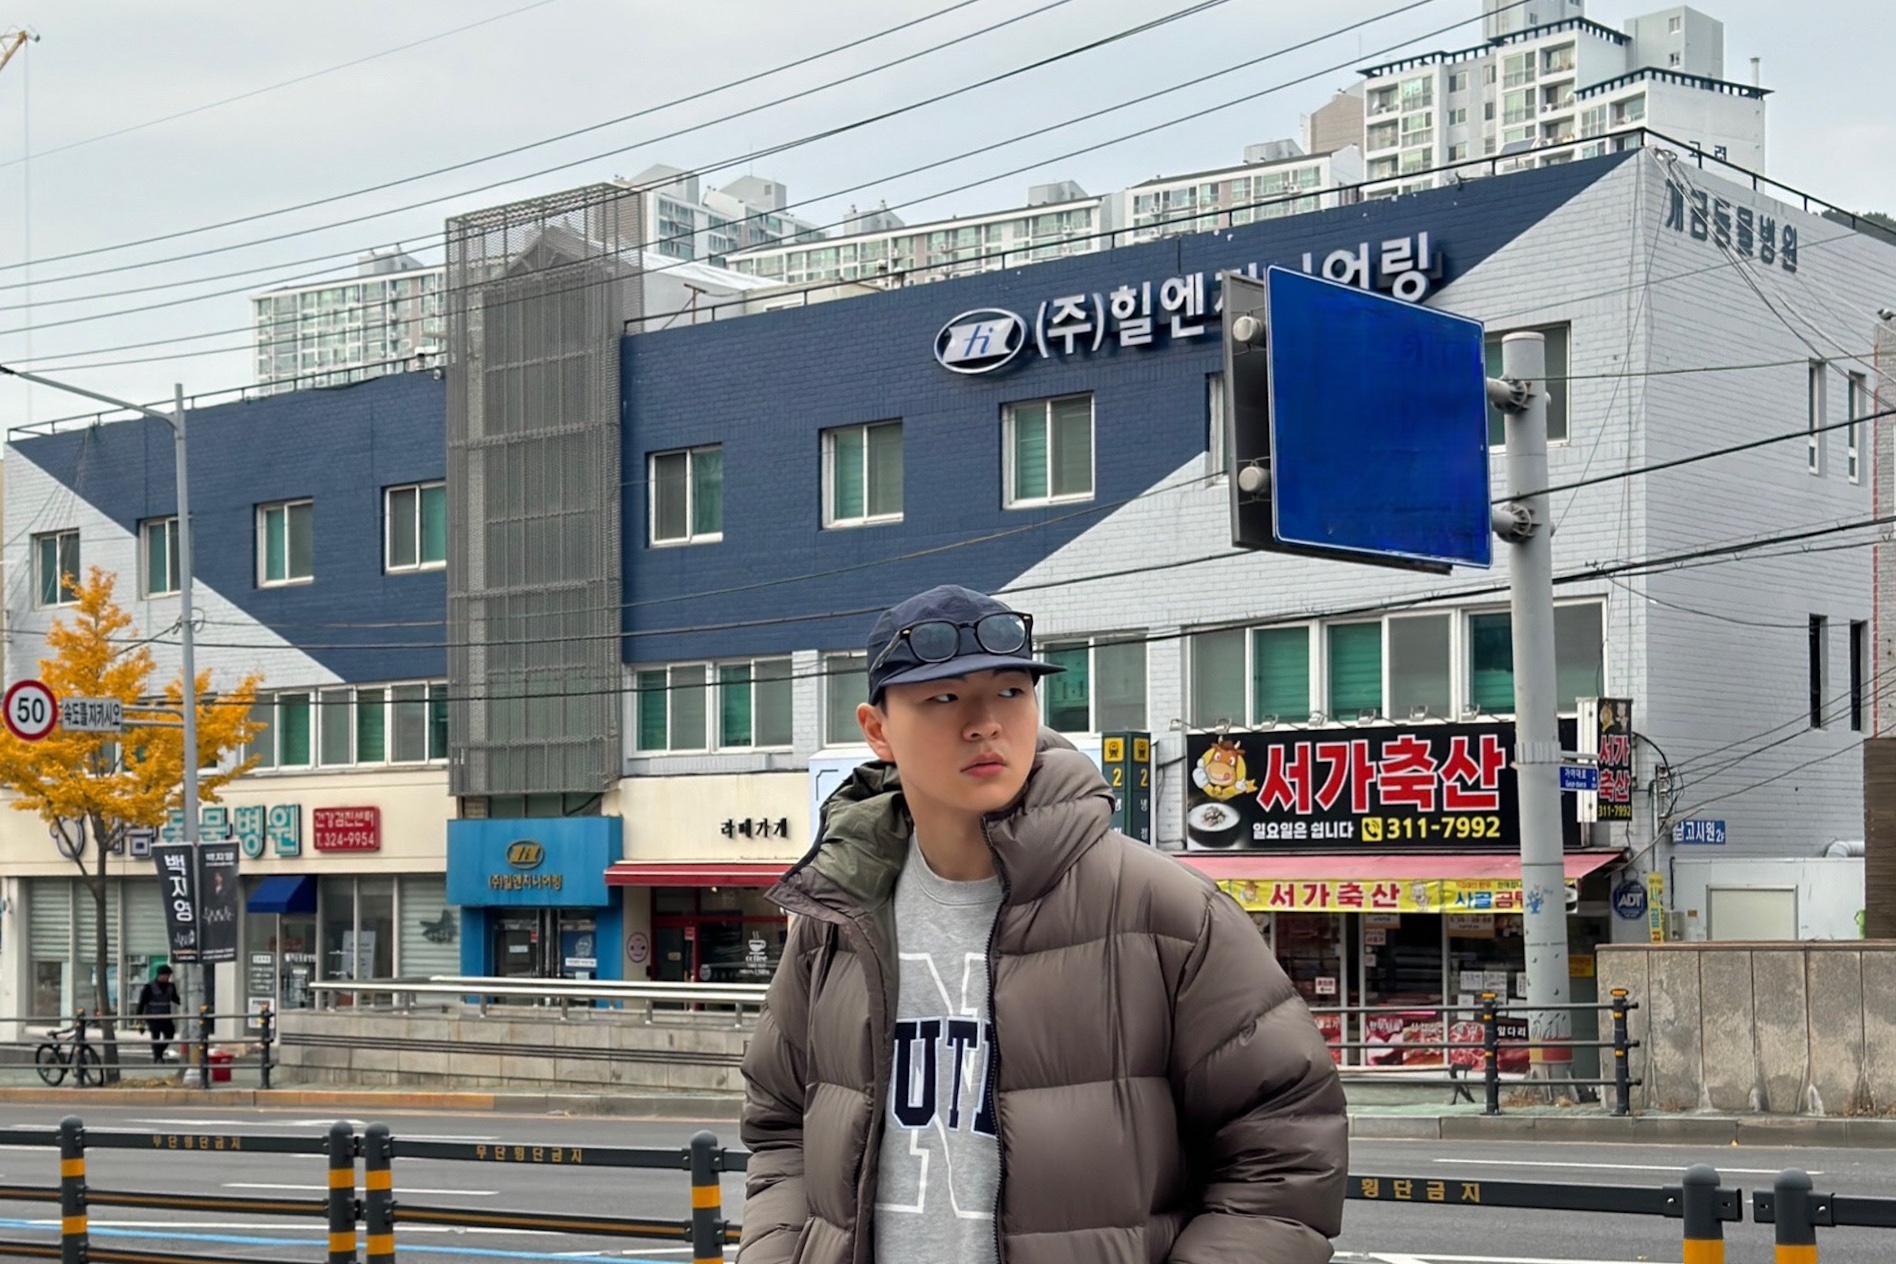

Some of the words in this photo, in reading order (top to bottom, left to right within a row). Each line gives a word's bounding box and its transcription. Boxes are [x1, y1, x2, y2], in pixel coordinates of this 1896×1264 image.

[1036, 231, 1431, 361] (주)힐엔어링
[17, 697, 45, 724] 50
[1113, 767, 1122, 787] 2
[1256, 733, 1506, 815] 서가축산
[1252, 822, 1307, 840] 일요일은
[1310, 820, 1354, 839] 쉽니다
[1386, 816, 1501, 839] 311-7992
[164, 854, 193, 922] 백지영
[1269, 882, 1400, 908] 서가축산
[1618, 893, 1643, 908] ADT
[476, 1145, 582, 1163] 무단횡단금지
